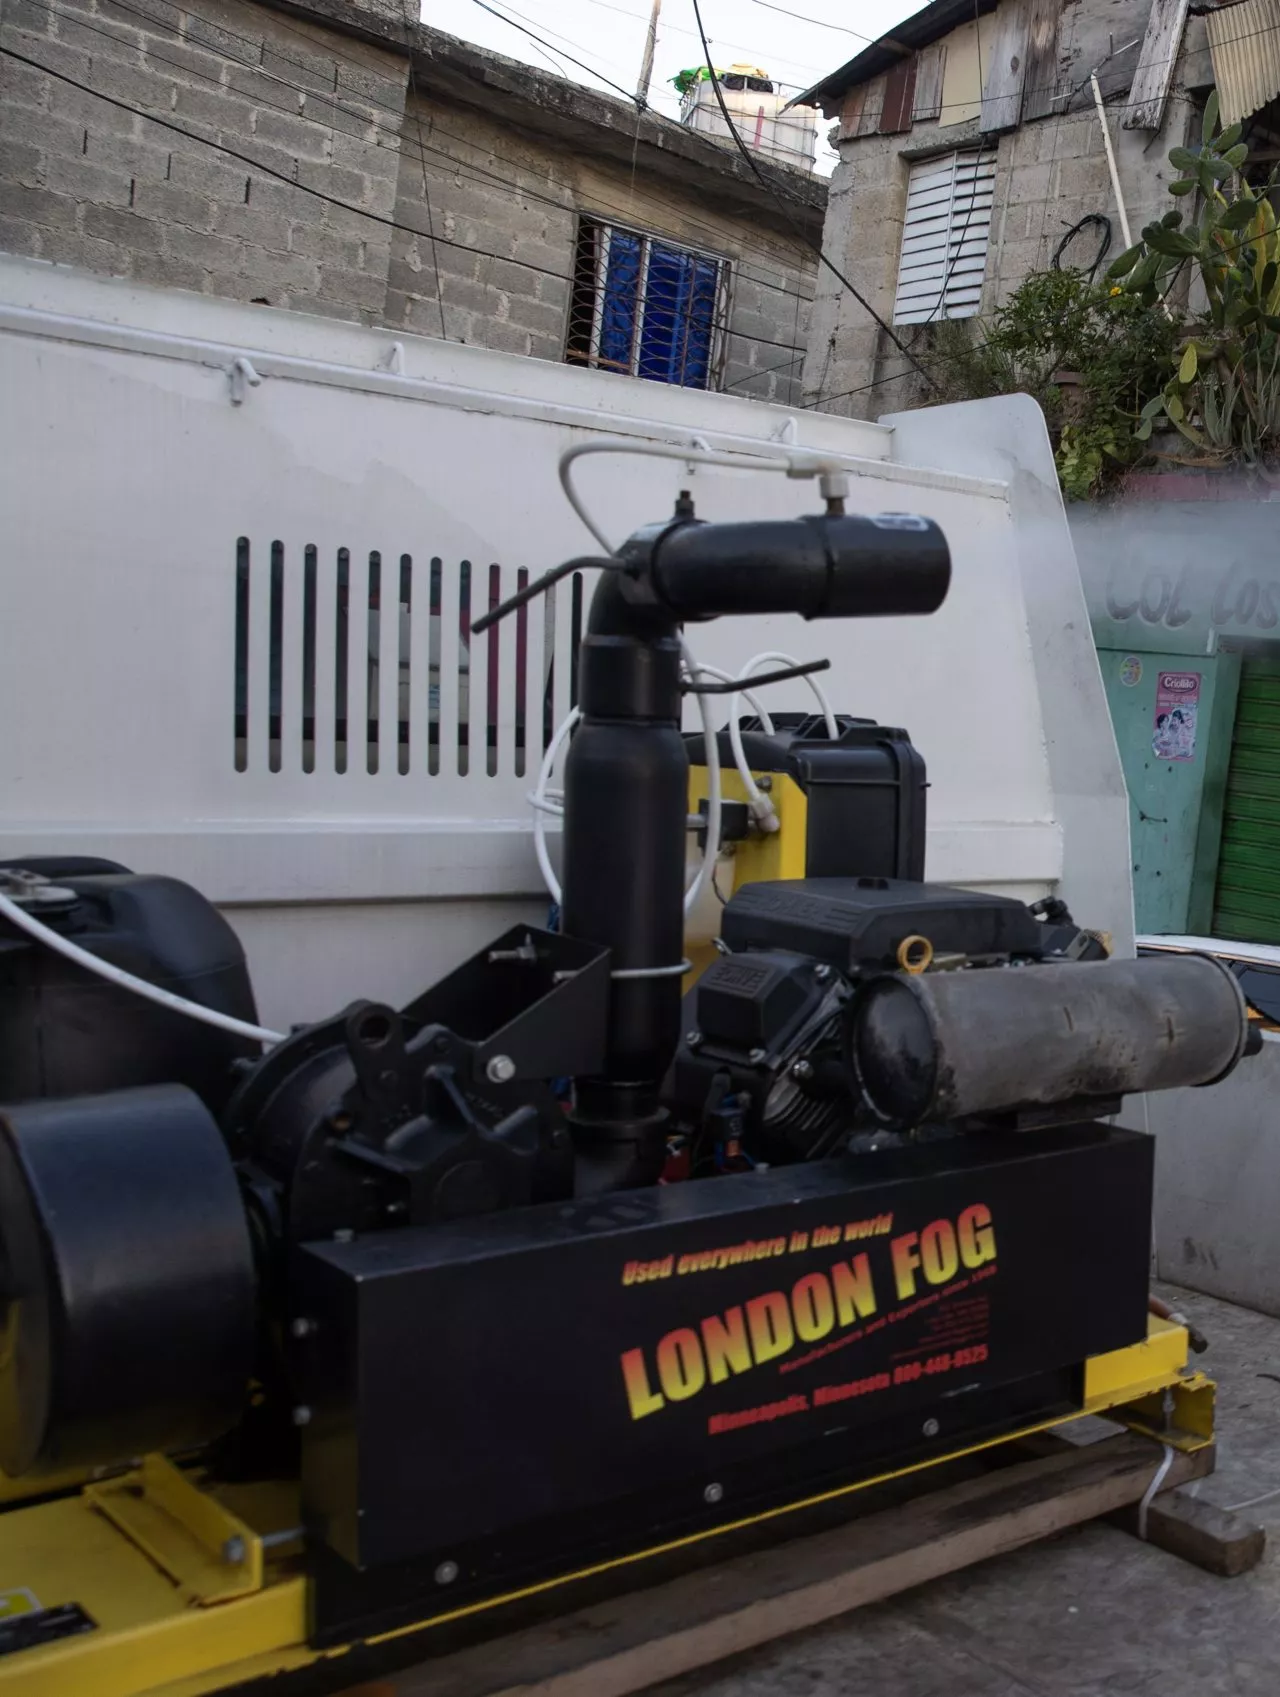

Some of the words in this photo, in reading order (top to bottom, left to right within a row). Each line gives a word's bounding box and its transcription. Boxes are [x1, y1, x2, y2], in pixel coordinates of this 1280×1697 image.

[619, 1252, 878, 1421] LONDON
[890, 1203, 998, 1301] FOG
[622, 1254, 674, 1287] Used
[677, 1236, 786, 1276] everywhere
[789, 1231, 809, 1253] in
[811, 1224, 842, 1249] the
[844, 1212, 894, 1243] world
